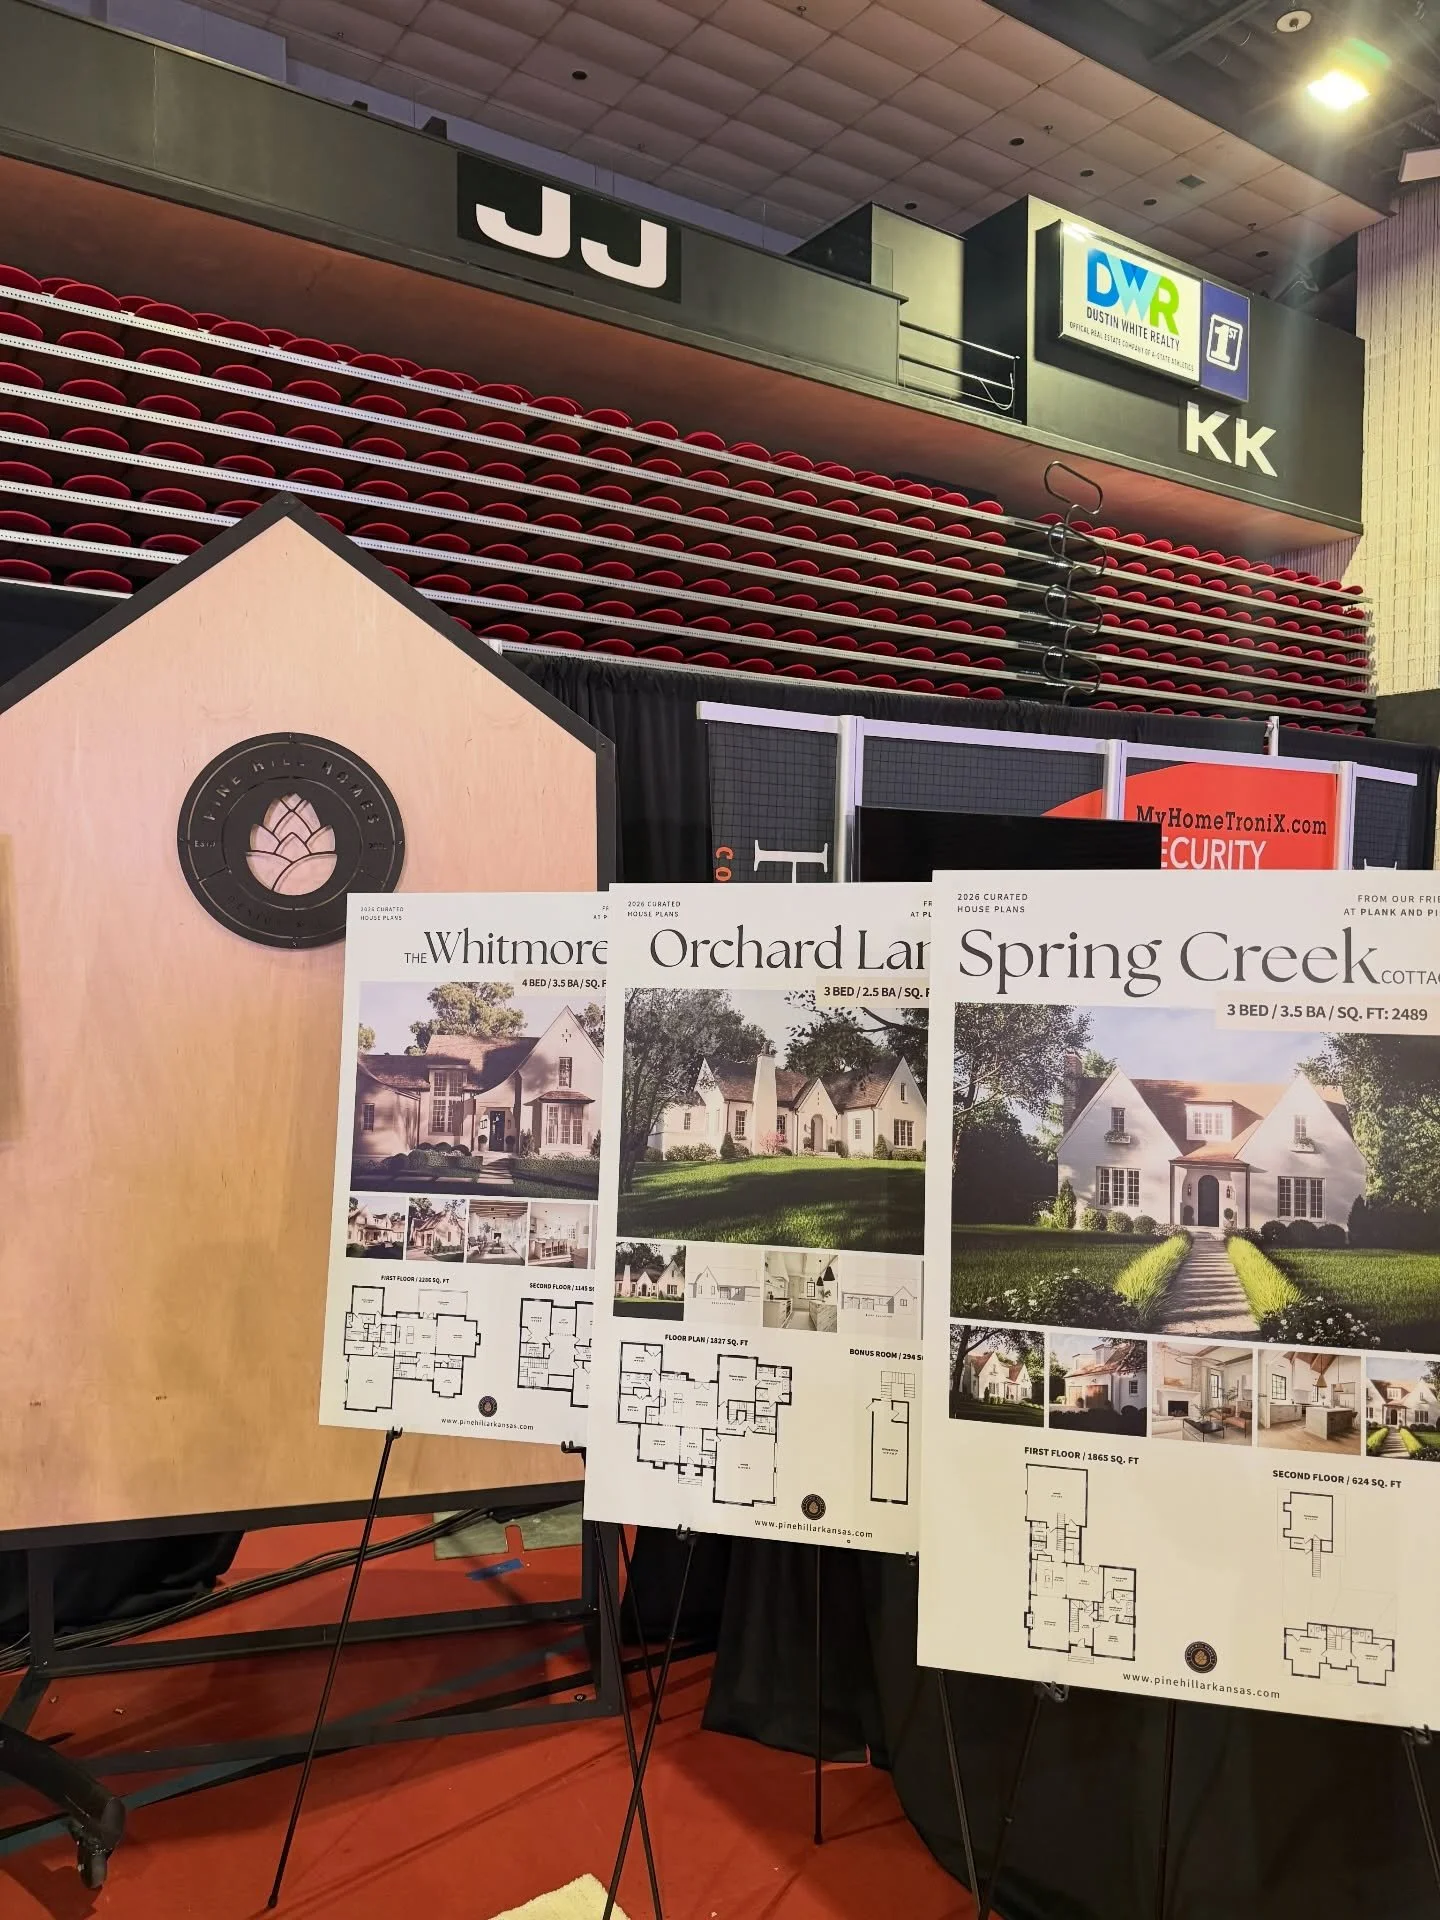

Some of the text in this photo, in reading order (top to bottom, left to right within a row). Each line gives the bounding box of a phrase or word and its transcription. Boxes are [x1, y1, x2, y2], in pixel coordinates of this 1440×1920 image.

[476, 186, 667, 288] JJ
[1087, 248, 1179, 335] DWR
[1086, 306, 1180, 352] DUSTIN WHITE REALTY
[1104, 333, 1121, 346] ESTATE
[1121, 340, 1144, 355] COMPANY
[1186, 400, 1278, 478] KK
[321, 760, 380, 824] HOMES
[1136, 805, 1327, 835] MyHomeTroniX.com
[957, 893, 1028, 901] 2026 CURATED
[1357, 894, 1387, 903] FROM
[1391, 895, 1415, 903] OUR
[957, 905, 1025, 913] HOUSE PLANS
[1343, 908, 1356, 916] AT
[1360, 908, 1397, 917] PLANK
[1400, 908, 1423, 917] AND
[404, 927, 608, 965] THE Whitmore
[649, 924, 842, 969] Orchard
[959, 926, 1440, 998] Spring Creek COTTA
[522, 979, 528, 988] 4
[529, 978, 546, 988] BED
[552, 979, 566, 988] 3.5
[567, 979, 580, 988] BA
[585, 979, 601, 990] SQ.
[824, 986, 831, 996] 3
[832, 987, 854, 997] BED
[862, 987, 879, 997] 2.5
[881, 988, 896, 998] BA
[904, 987, 923, 1000] SQ.
[1227, 1004, 1236, 1016] 3
[1239, 1004, 1269, 1017] BED
[1280, 1005, 1303, 1018] 3.5
[1306, 1005, 1327, 1018] BA
[1337, 1006, 1363, 1021] SQ.
[1366, 1007, 1389, 1020] FT:
[1392, 1008, 1428, 1021] 2489
[552, 1283, 572, 1291] FLOOR
[664, 1334, 687, 1342] FLOOR
[688, 1335, 706, 1343] PLAN
[726, 1338, 739, 1346] SQ.
[849, 1348, 875, 1356] BONUS
[875, 1350, 898, 1358] ROOM
[902, 1353, 916, 1361] 294
[1024, 1446, 1050, 1456] FIRST
[1051, 1449, 1081, 1459] FLOOR
[1087, 1453, 1109, 1462] 1865
[1110, 1455, 1126, 1465] SQ.
[1128, 1456, 1140, 1464] FT
[1272, 1469, 1311, 1480] SECOND
[1312, 1473, 1344, 1484] FLOOR
[1352, 1477, 1369, 1486] 624
[1371, 1478, 1388, 1488] SQ.
[1390, 1480, 1402, 1488] FT
[754, 1519, 873, 1538] www.pinehillarkansas.com
[1122, 1672, 1280, 1699] www.pinehillarkansas.com
